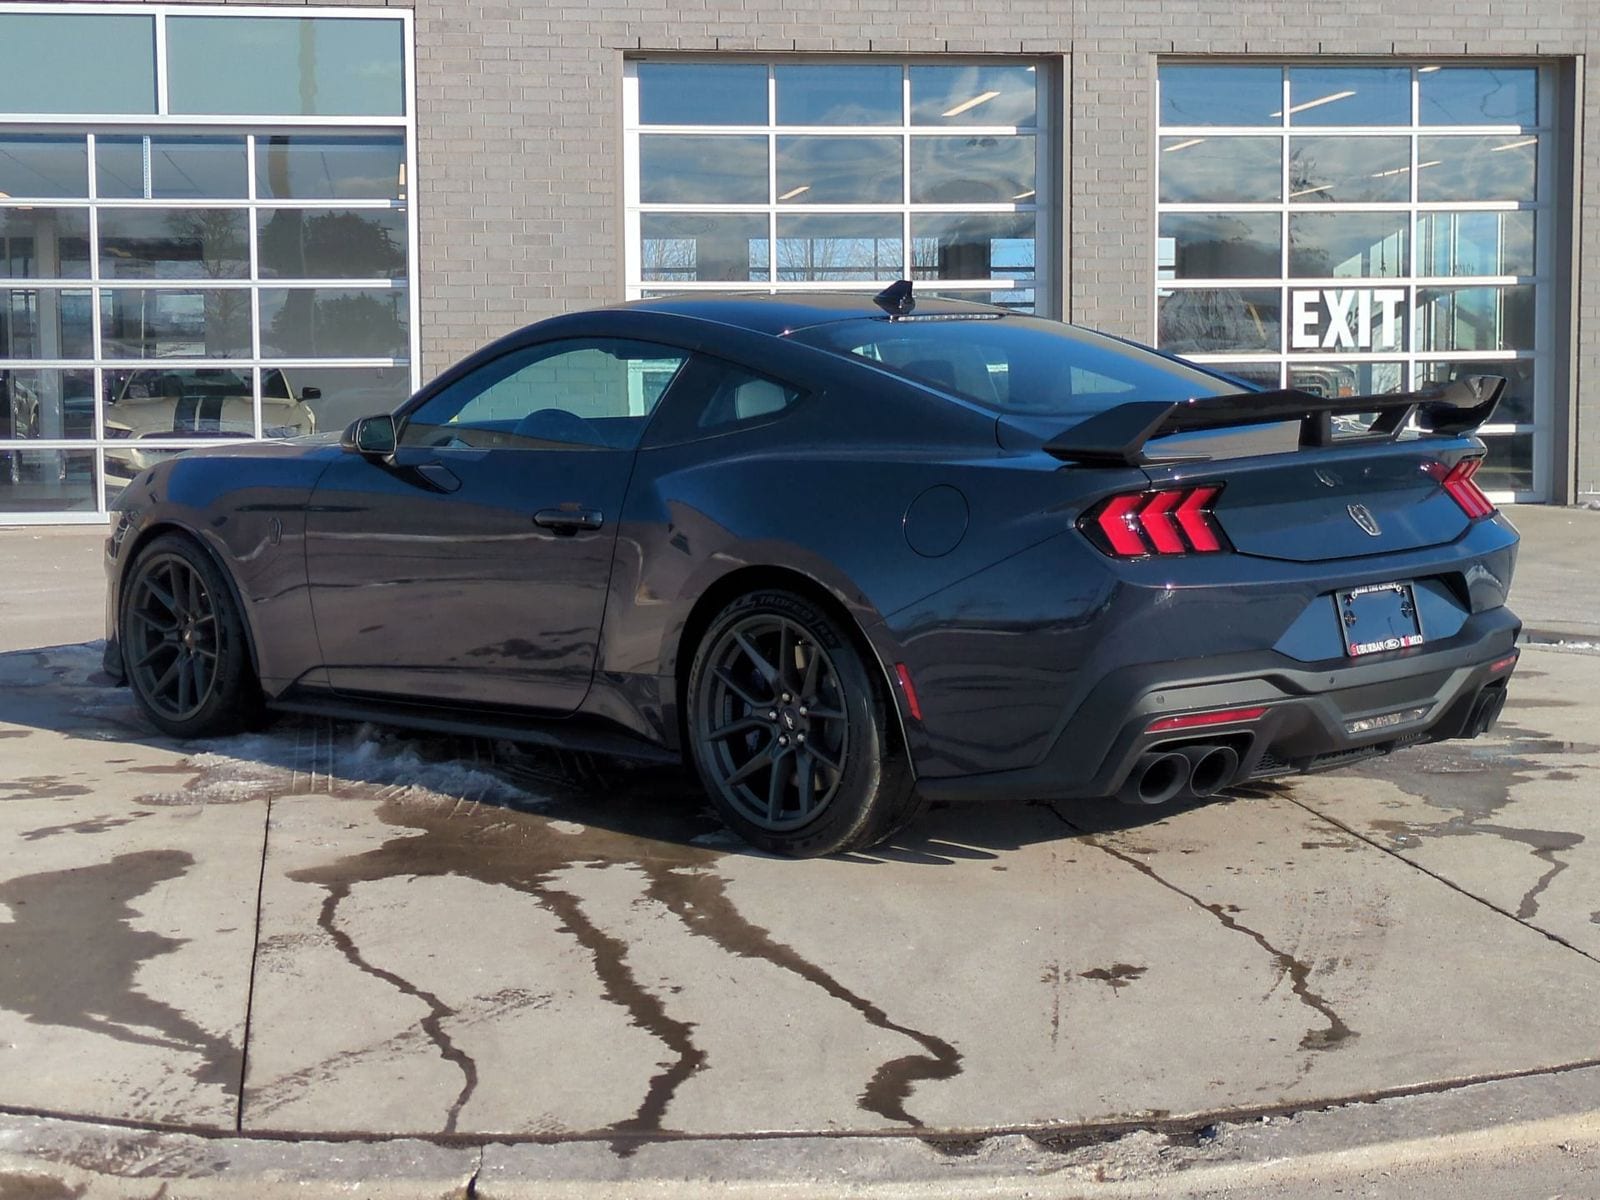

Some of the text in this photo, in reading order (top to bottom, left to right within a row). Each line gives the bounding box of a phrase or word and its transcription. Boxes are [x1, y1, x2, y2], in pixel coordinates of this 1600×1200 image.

[1292, 289, 1405, 348] EXIT
[1350, 641, 1385, 656] SUBURBAN
[1385, 639, 1399, 649] Ford
